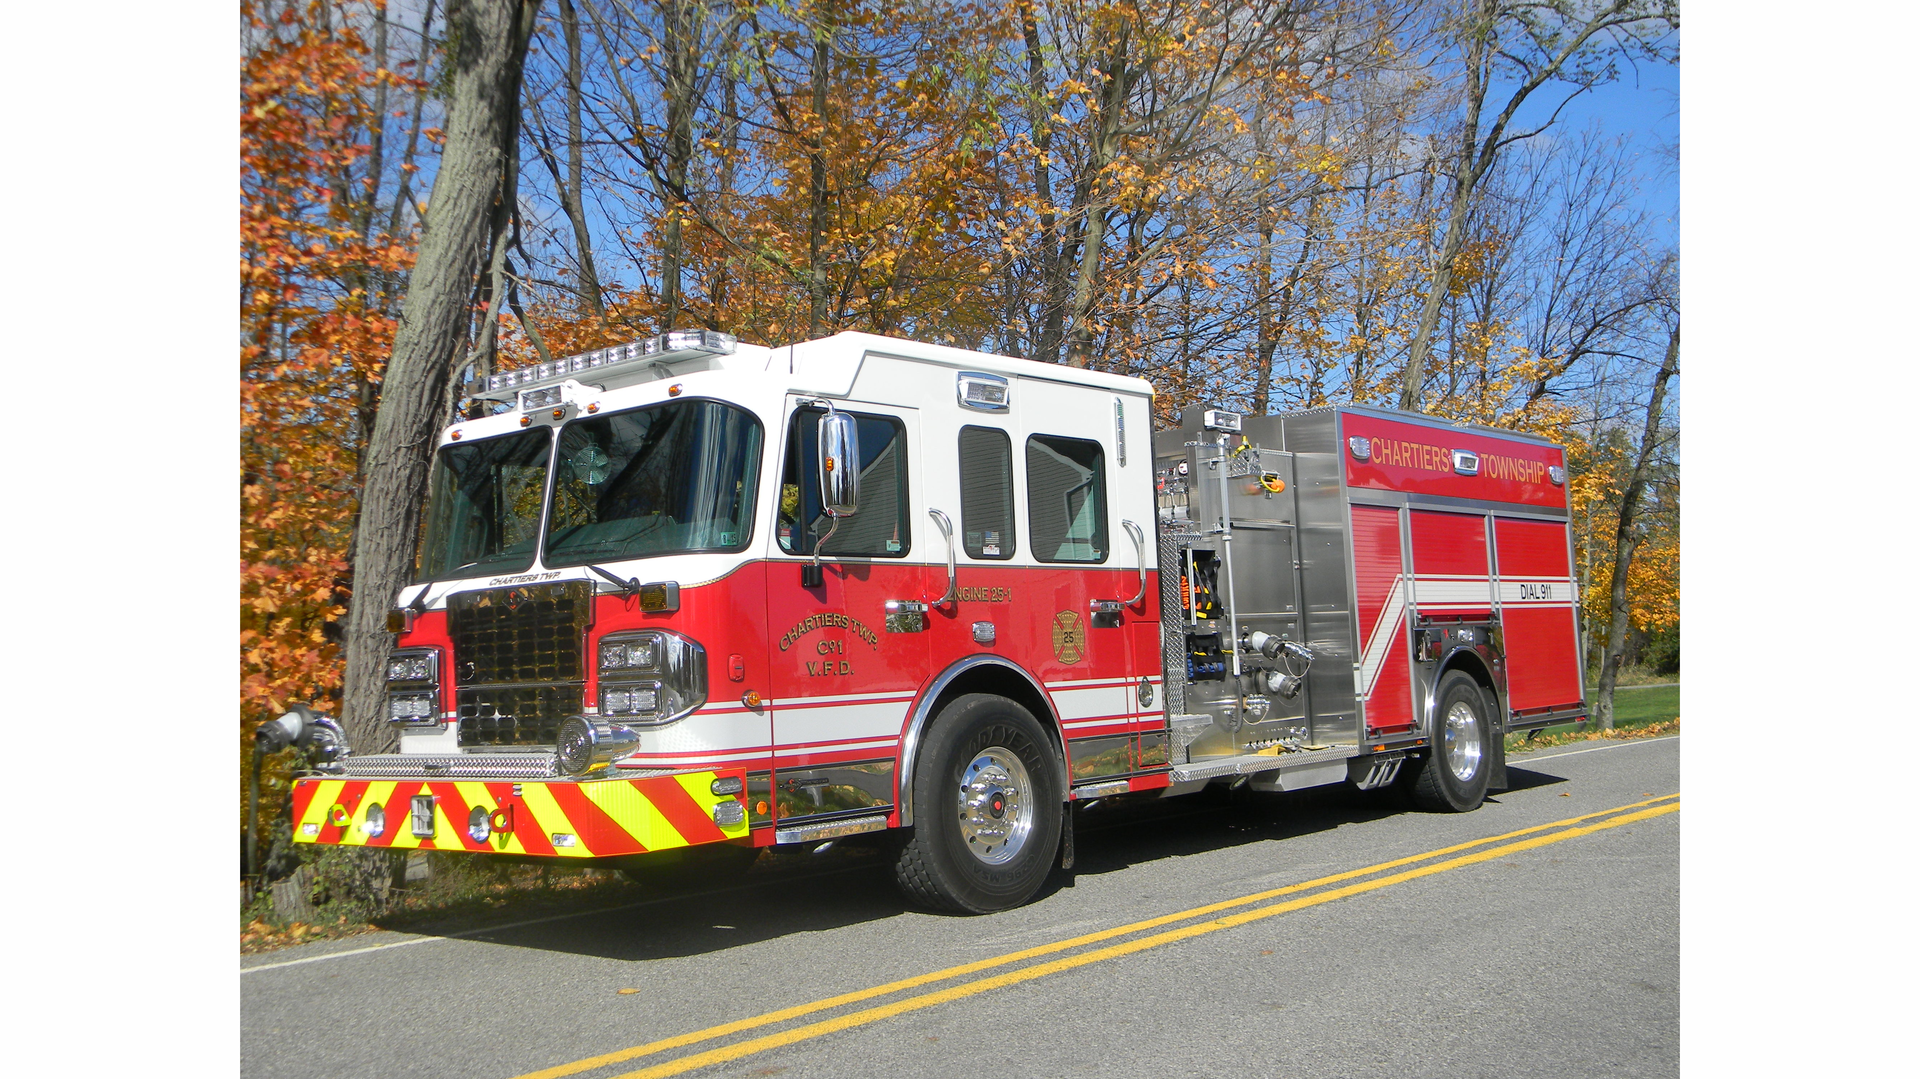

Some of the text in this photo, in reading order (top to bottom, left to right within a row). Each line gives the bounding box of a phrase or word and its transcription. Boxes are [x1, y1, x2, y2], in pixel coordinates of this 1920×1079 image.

[1370, 436, 1545, 485] CHARTIERS TOWNSHIP
[488, 573, 539, 587] CHARTIERS
[990, 586, 1012, 603] 25-1
[1520, 583, 1552, 600] DIAL 911
[779, 612, 878, 652] CHARTIERS TWP.
[1063, 631, 1075, 644] 25
[806, 660, 855, 676] V.F.D.
